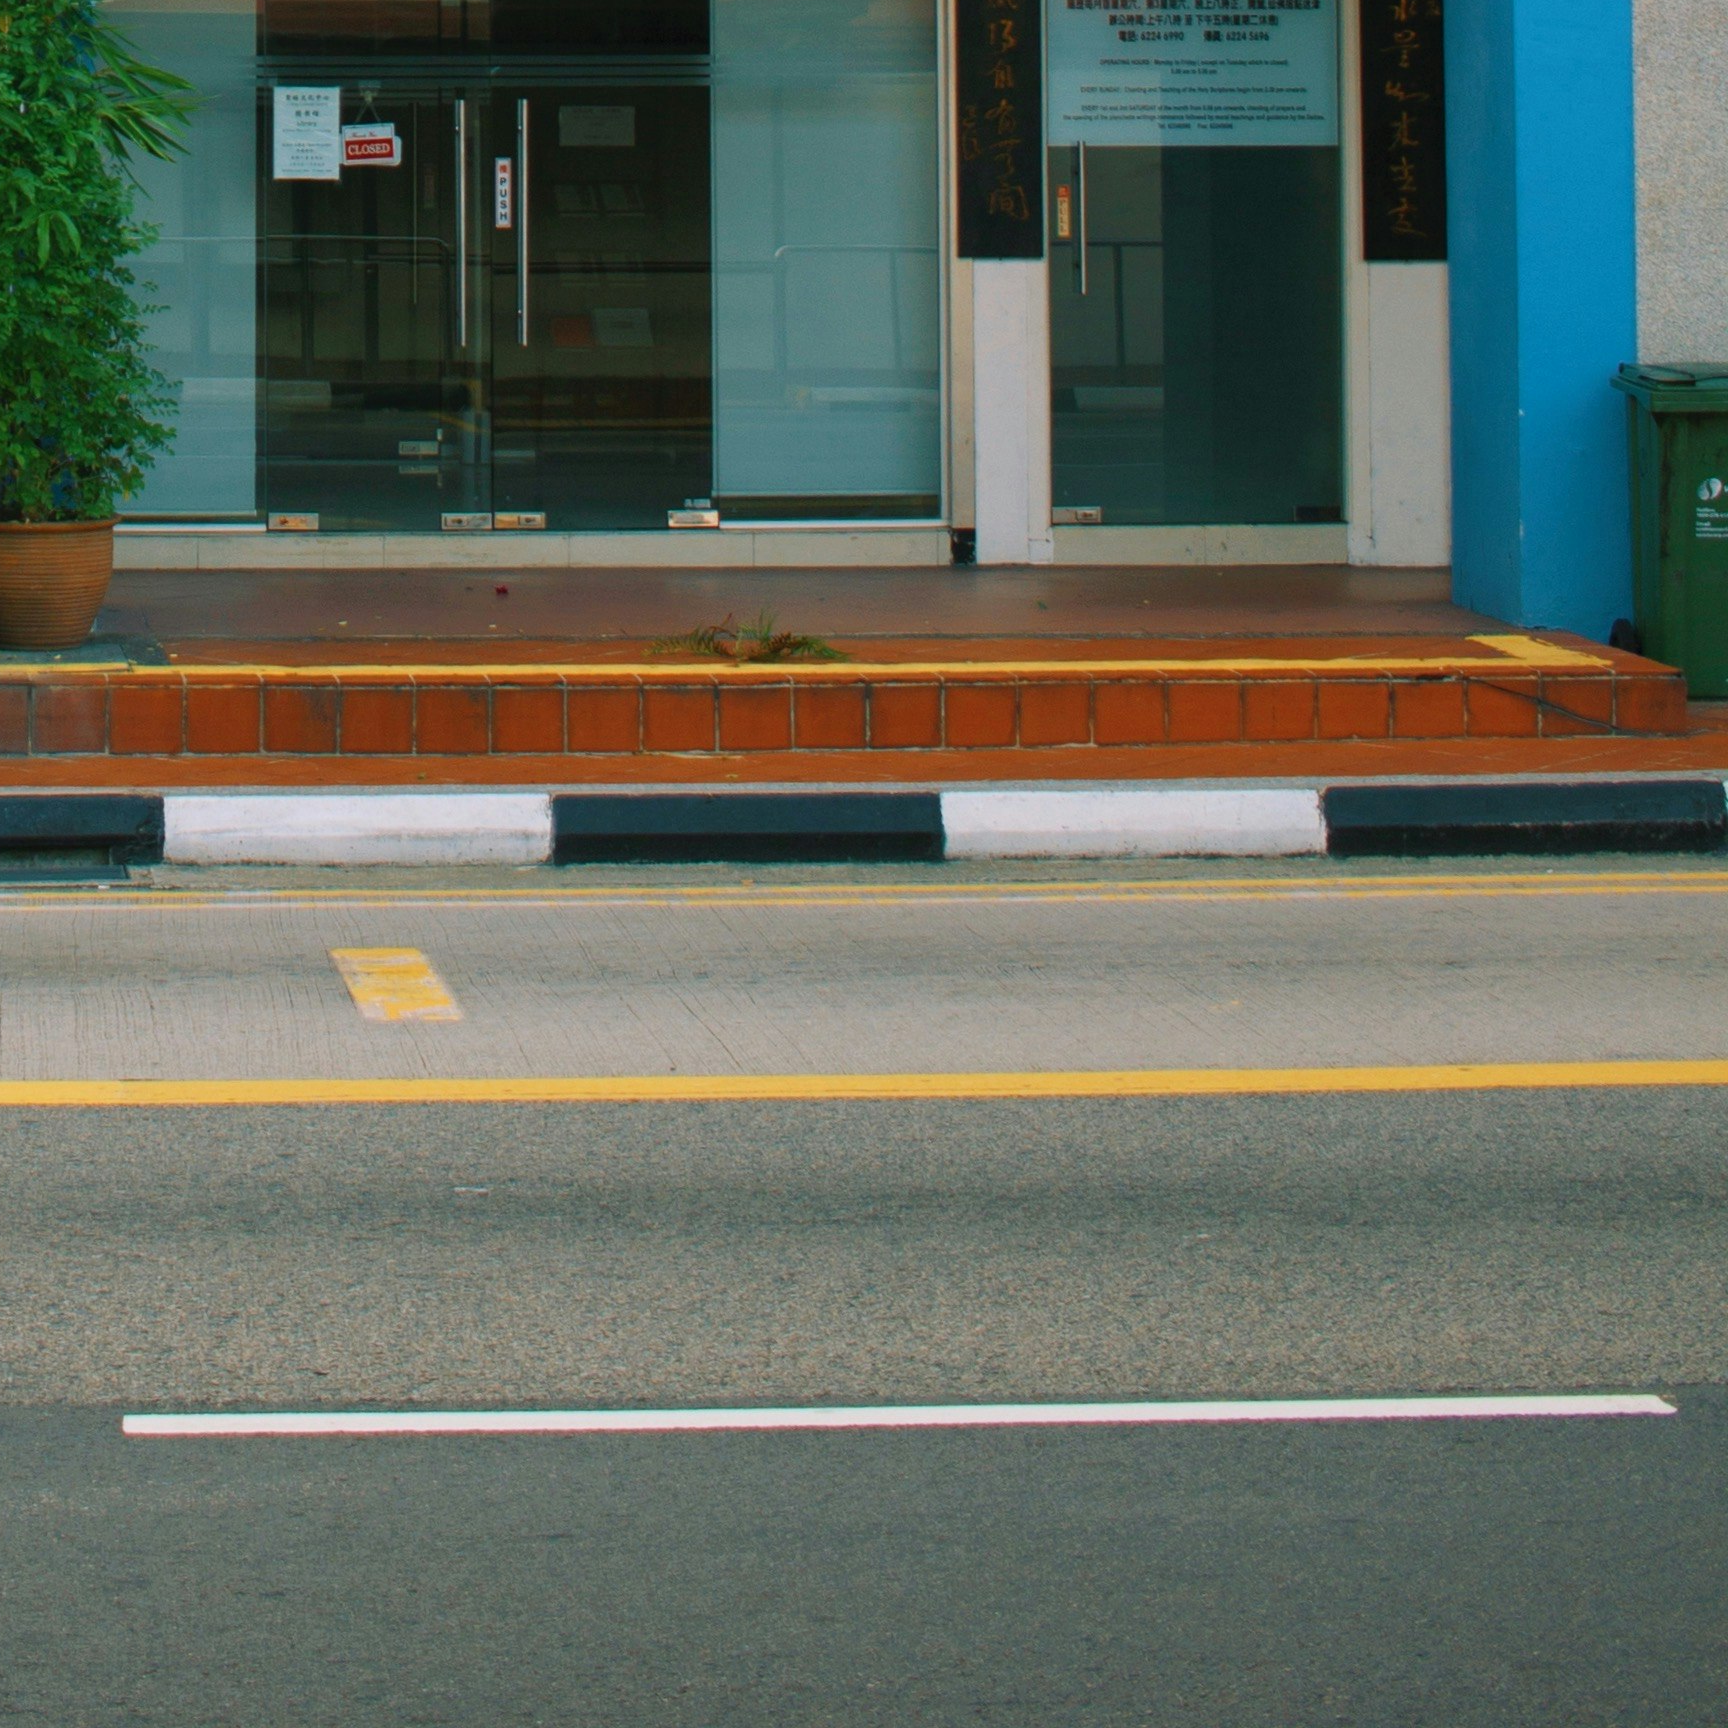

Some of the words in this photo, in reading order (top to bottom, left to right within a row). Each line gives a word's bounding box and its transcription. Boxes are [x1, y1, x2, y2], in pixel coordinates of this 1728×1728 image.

[1140, 31, 1162, 42] 6224
[347, 142, 391, 156] CLOSED
[499, 177, 508, 221] PUSH
